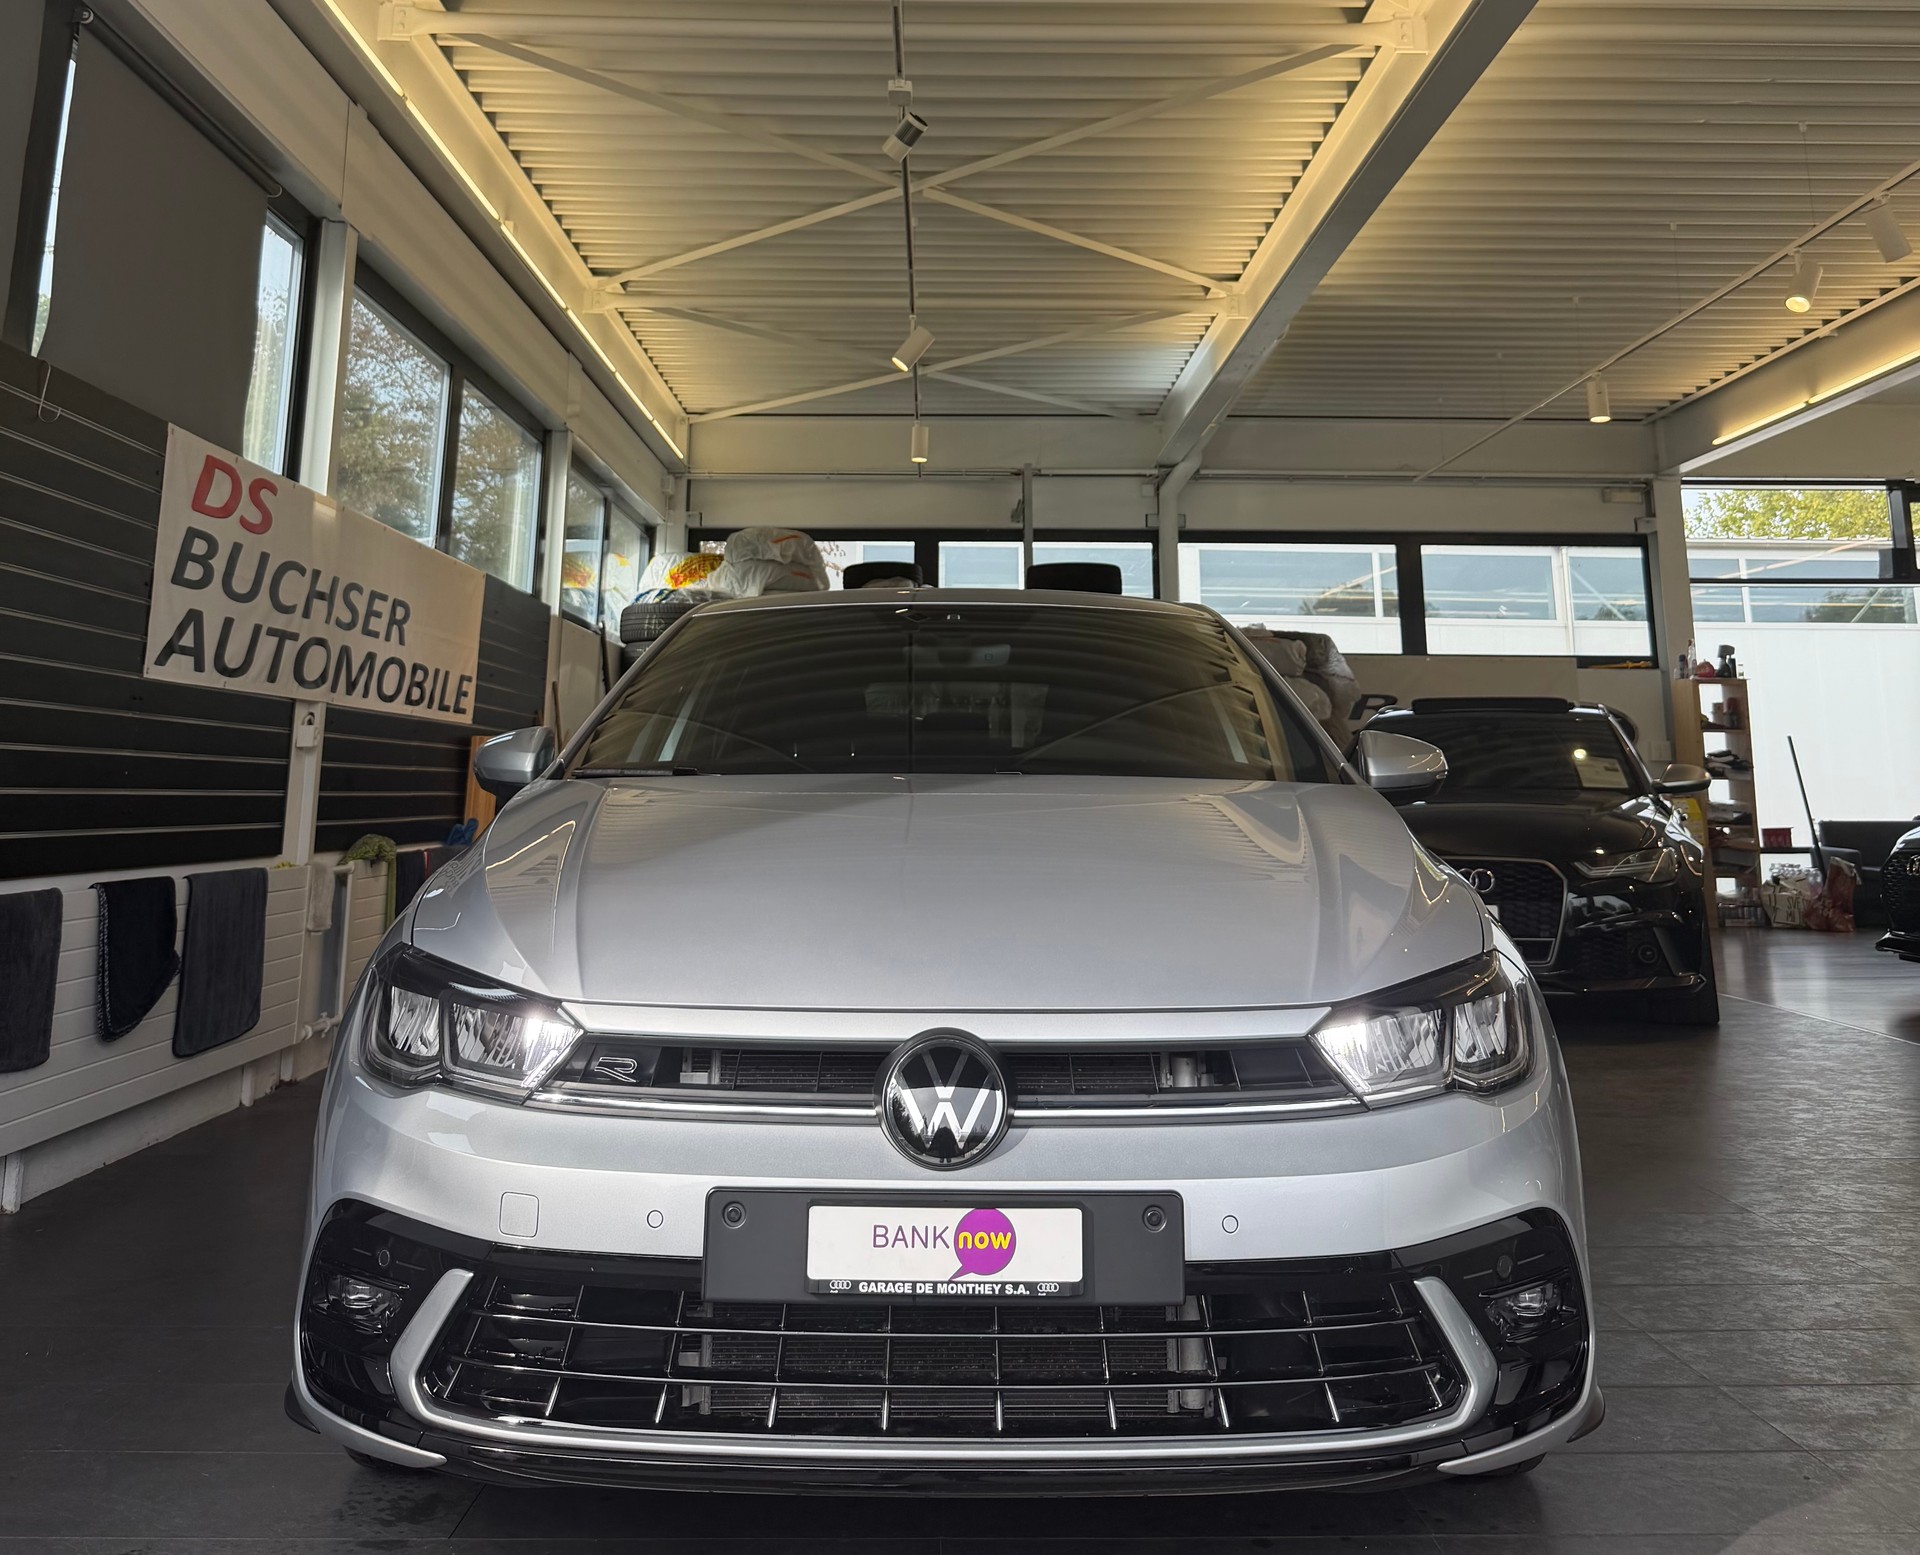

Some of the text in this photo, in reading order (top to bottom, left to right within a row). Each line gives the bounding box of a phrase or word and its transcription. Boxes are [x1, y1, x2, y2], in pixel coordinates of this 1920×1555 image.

[191, 454, 279, 535] DS
[170, 525, 412, 646] BUCHSER
[153, 607, 473, 715] AUTOMOBILE
[872, 1224, 1012, 1250] BANK now
[858, 1281, 1030, 1295] GARAGE DE MONTHEY S.A.
